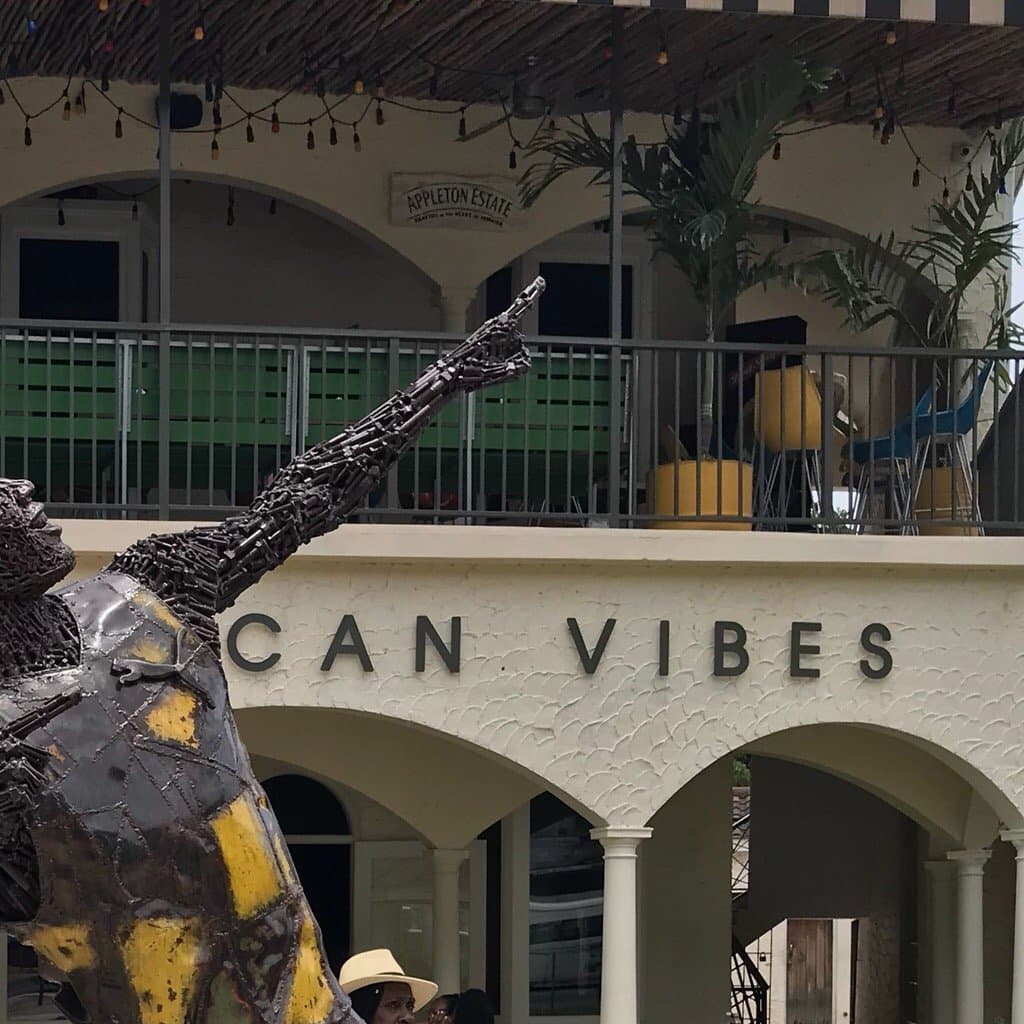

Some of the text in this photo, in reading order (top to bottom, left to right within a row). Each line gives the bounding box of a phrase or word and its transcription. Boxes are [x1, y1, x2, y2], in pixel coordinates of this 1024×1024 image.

[407, 187, 513, 217] APPLETON ESTATE
[566, 617, 894, 680] VIBES
